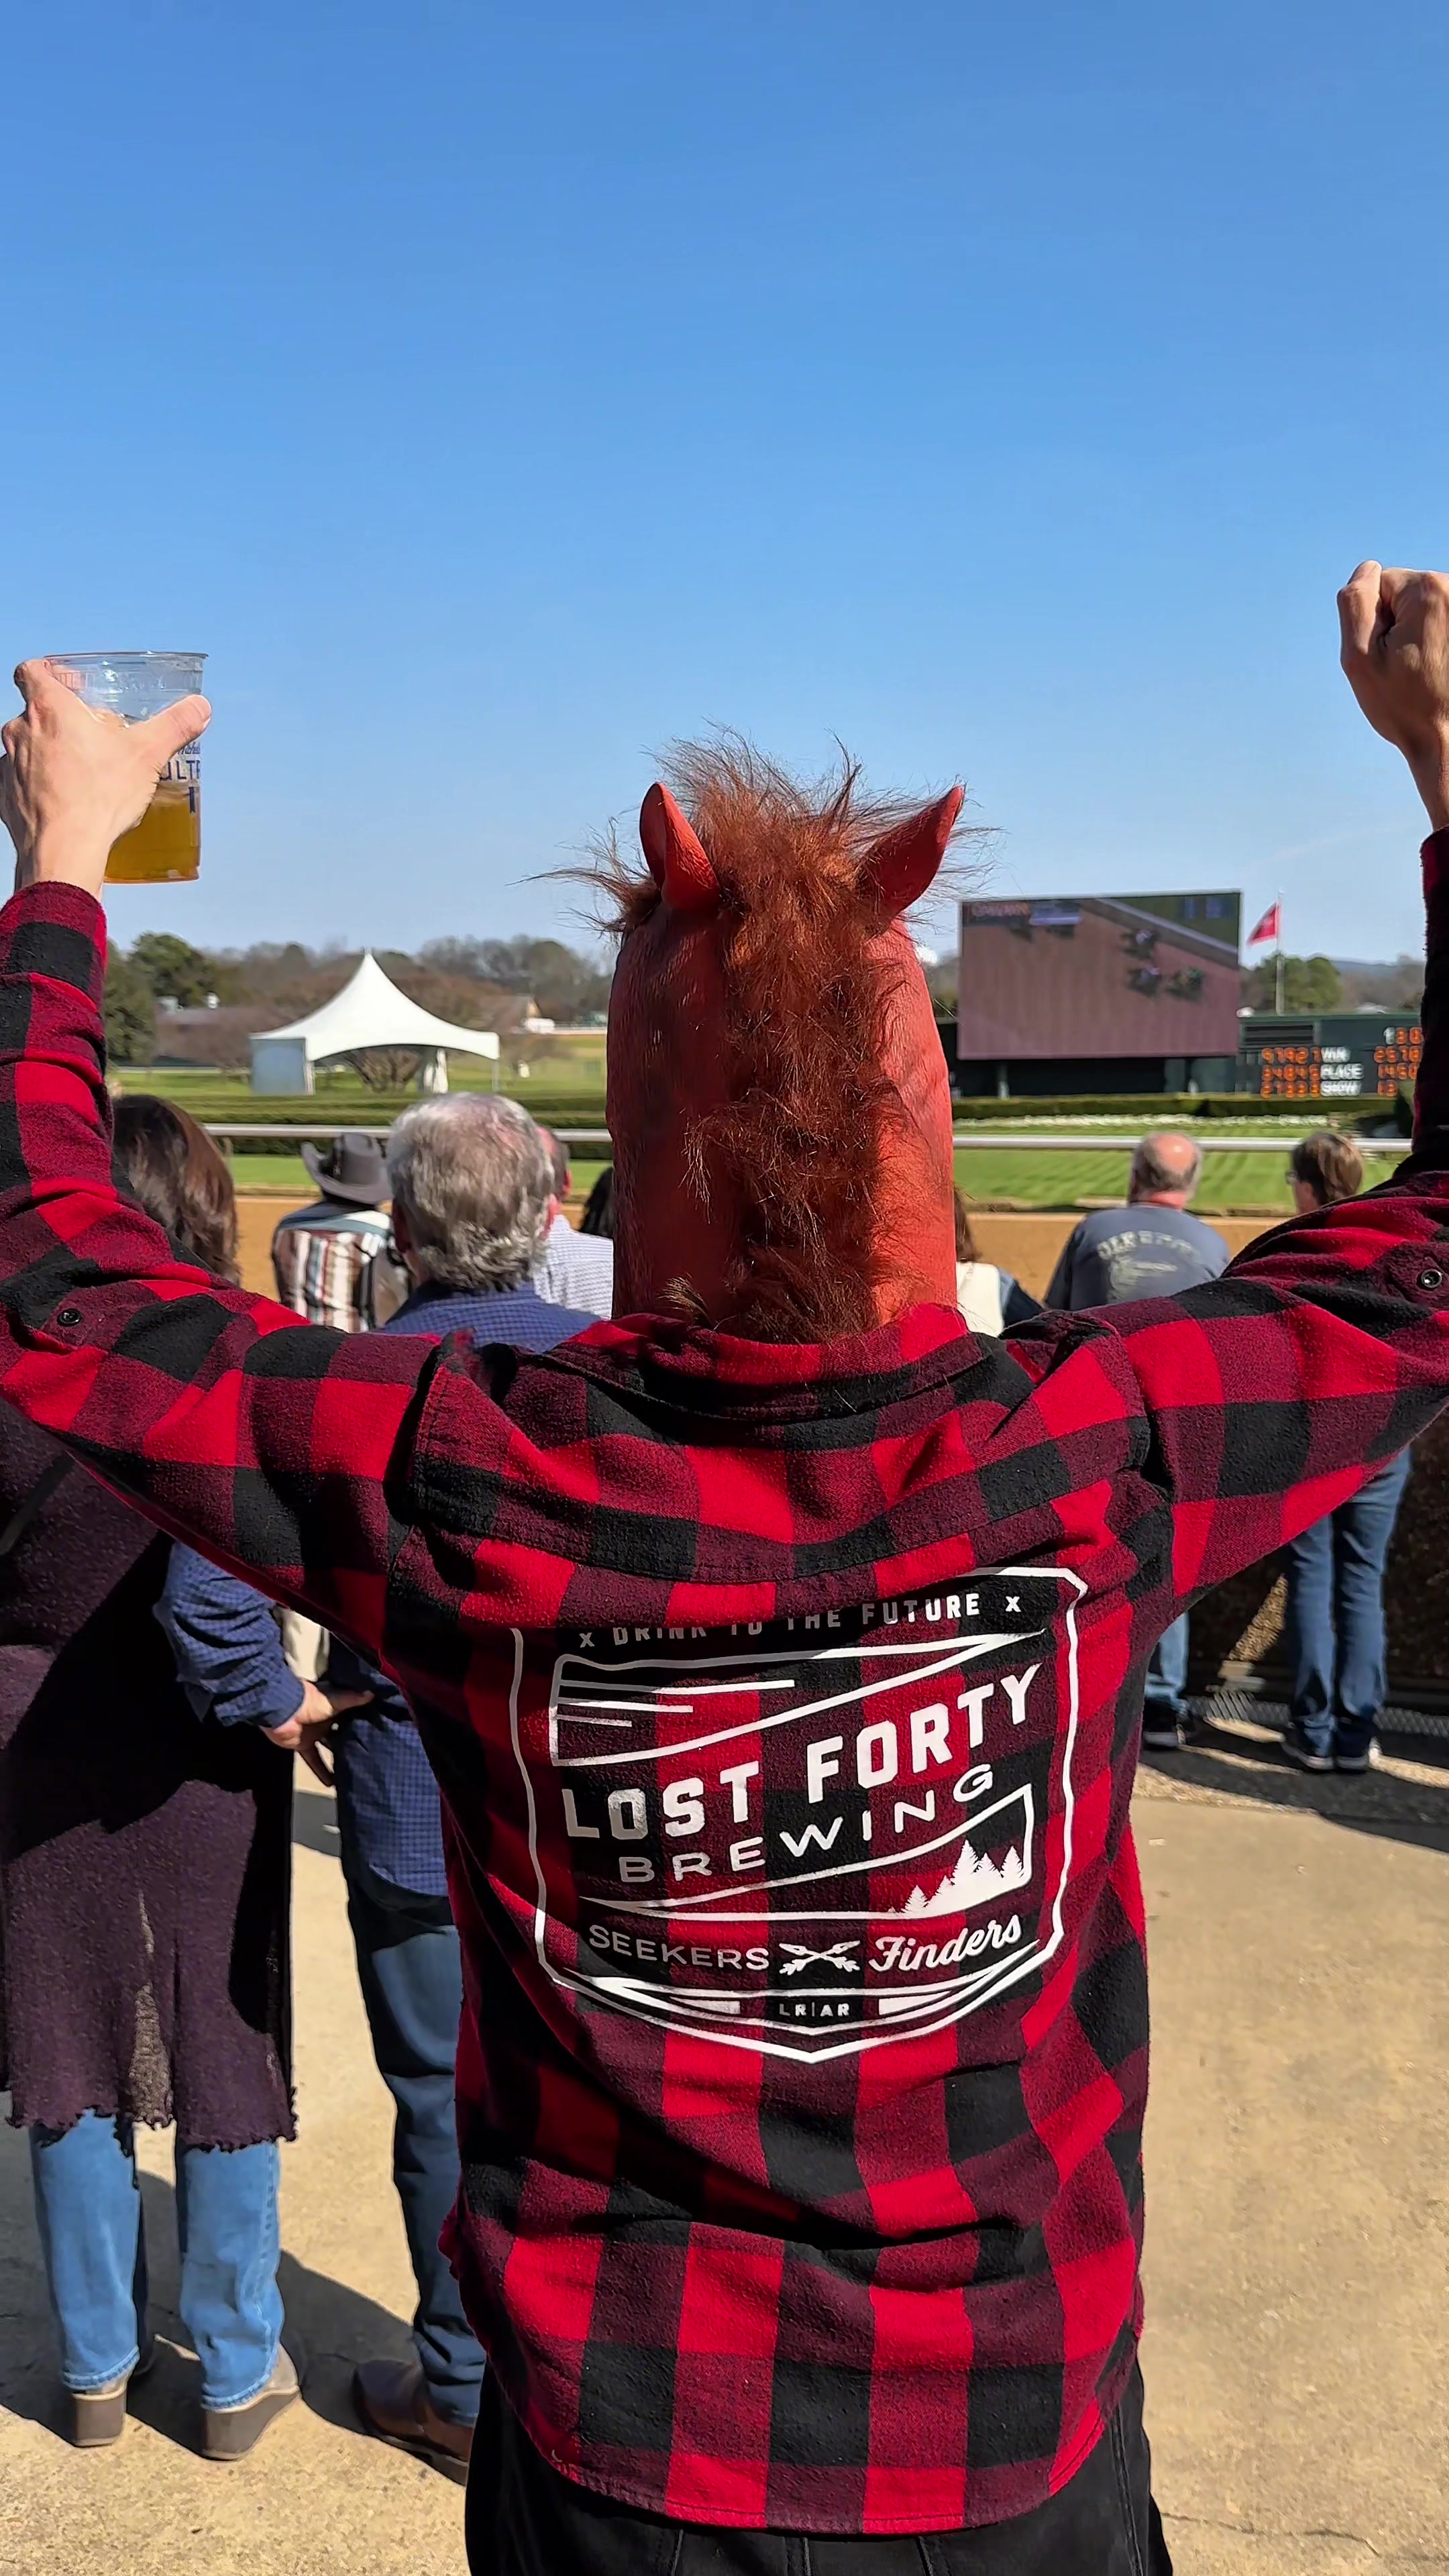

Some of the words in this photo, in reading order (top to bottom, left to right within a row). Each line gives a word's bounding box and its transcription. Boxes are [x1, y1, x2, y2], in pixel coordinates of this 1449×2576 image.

[1321, 1046, 1350, 1063] WIN
[1320, 1063, 1364, 1079] PLACE
[1320, 1080, 1362, 1097] SHOW
[862, 1593, 980, 1625] FUTURE
[561, 1760, 759, 1840] LOST
[806, 1662, 1042, 1804] FORTY
[619, 1763, 994, 1883] BREWING
[588, 1924, 770, 1971] SEEKERS
[868, 1914, 1022, 1972] Finders
